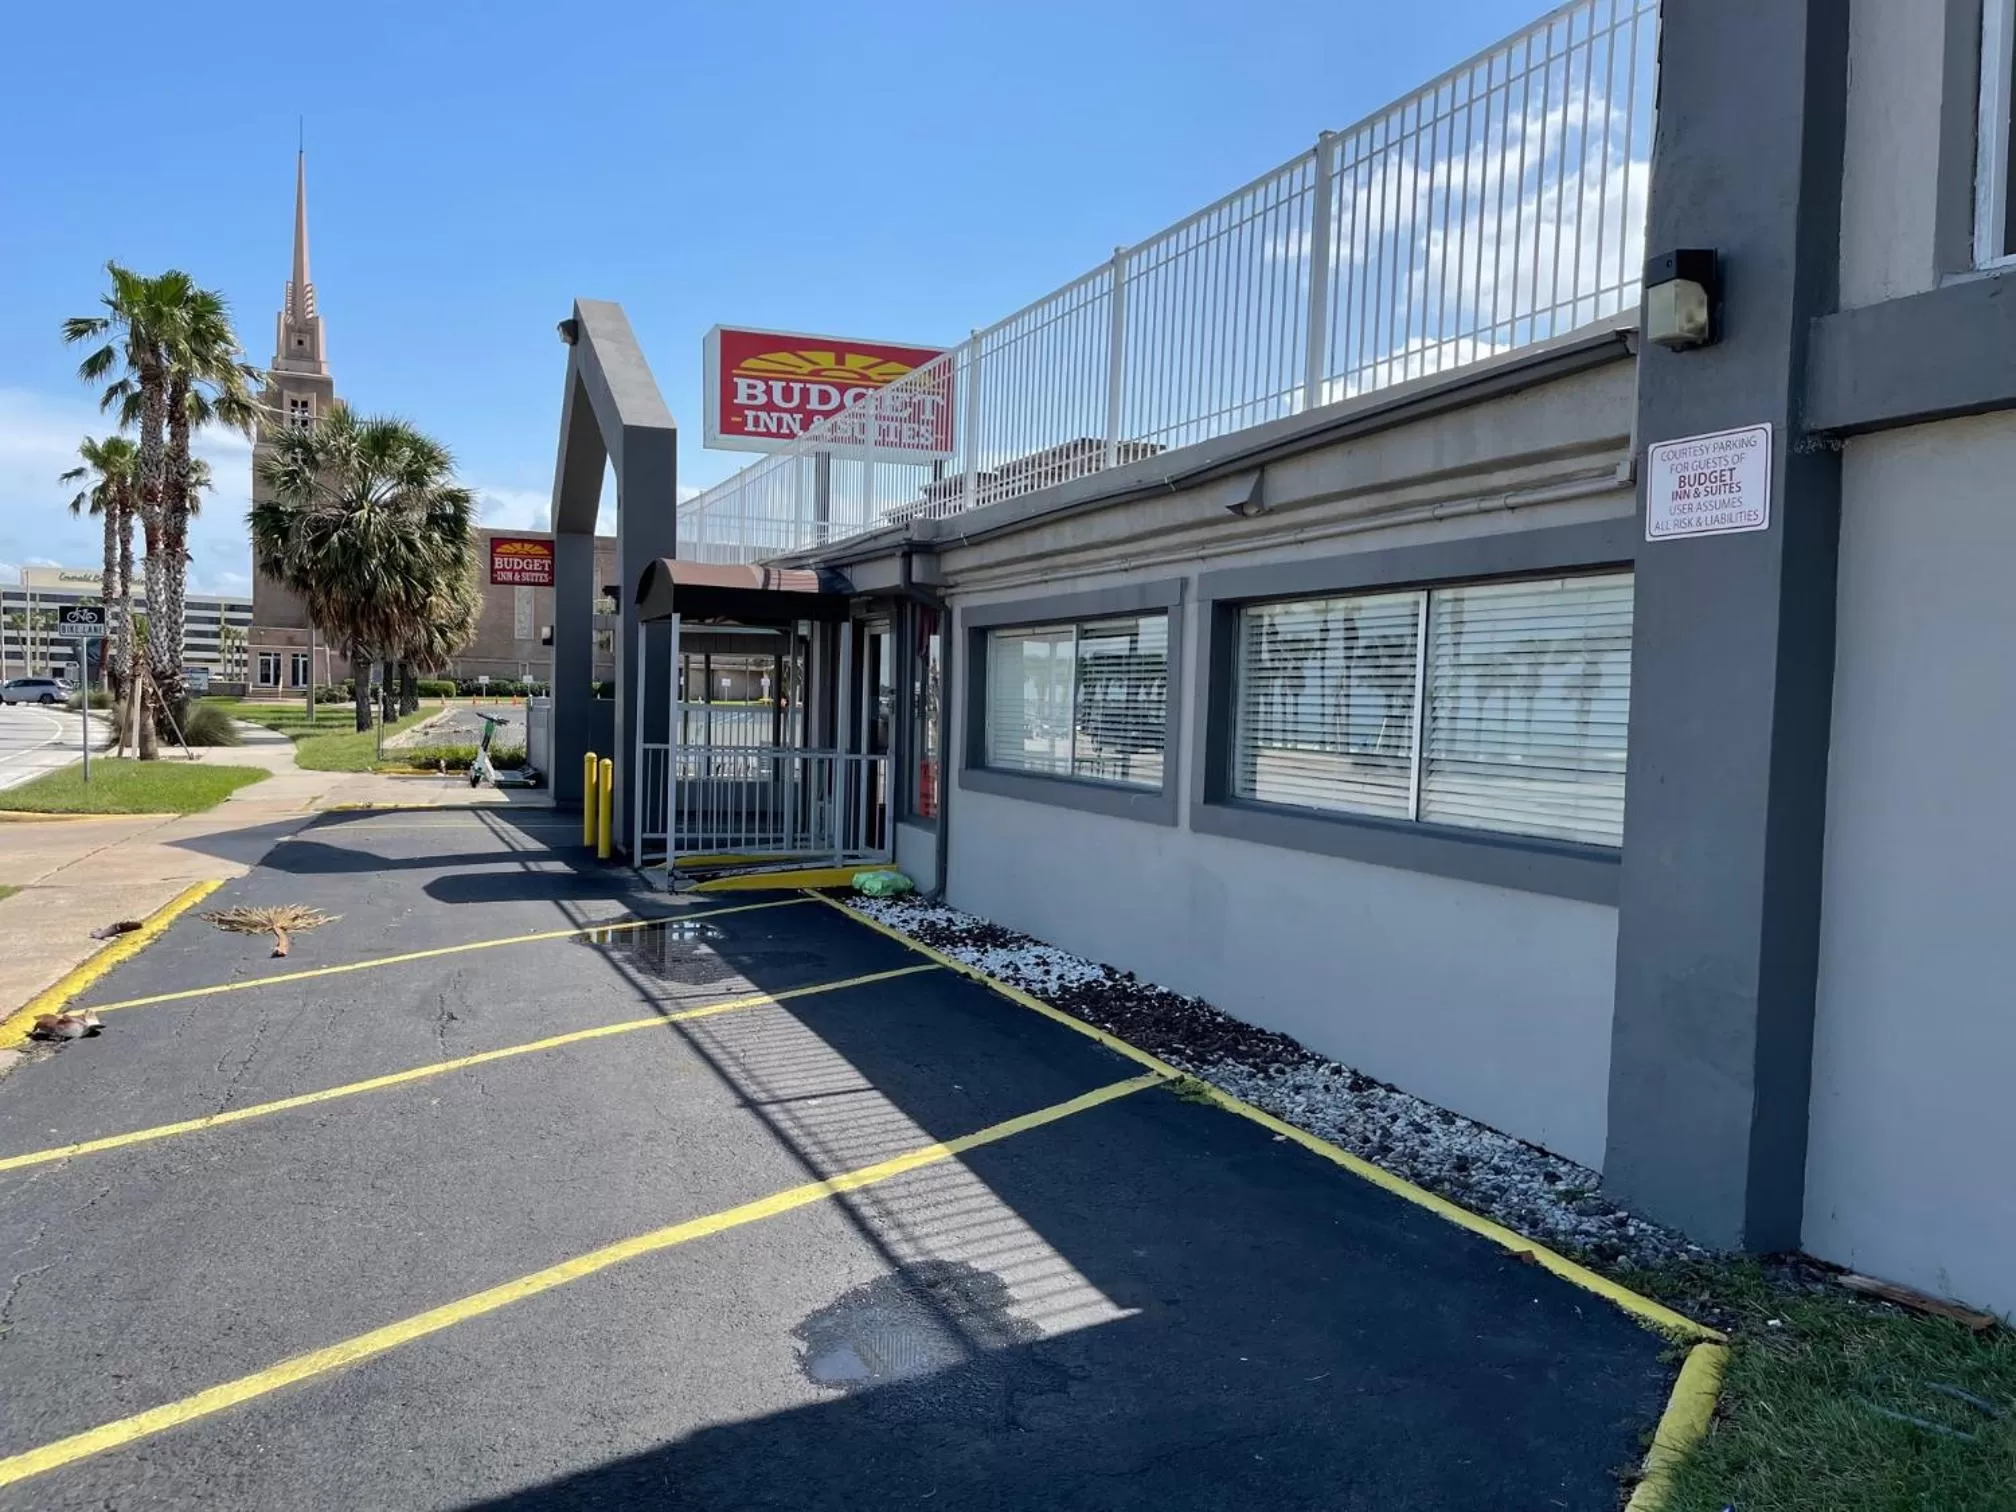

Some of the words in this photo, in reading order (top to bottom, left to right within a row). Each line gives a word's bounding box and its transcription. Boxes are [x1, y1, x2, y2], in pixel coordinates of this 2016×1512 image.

[743, 409, 803, 435] INN
[1660, 444, 1710, 462] COURTESY
[1711, 435, 1757, 452] PARKING
[1670, 461, 1689, 474] FOR
[1691, 456, 1729, 471] GUESTS
[1731, 452, 1746, 467] OF
[1678, 467, 1736, 489] BUDGET
[1671, 490, 1690, 502] INN
[1693, 487, 1701, 498] &
[1703, 482, 1742, 497] SUITES
[1669, 503, 1693, 516] USER
[1695, 497, 1743, 513] ASSUMES
[1655, 519, 1671, 532] ALL
[1673, 517, 1693, 530] RISK
[1695, 516, 1703, 527] &
[1705, 509, 1759, 526] LIABILITIES
[494, 557, 551, 571] BUDGET
[497, 571, 513, 581] INN
[514, 572, 520, 582] &
[521, 572, 548, 582] SUITES
[61, 624, 79, 634] BIKE
[82, 624, 103, 634] LANE
